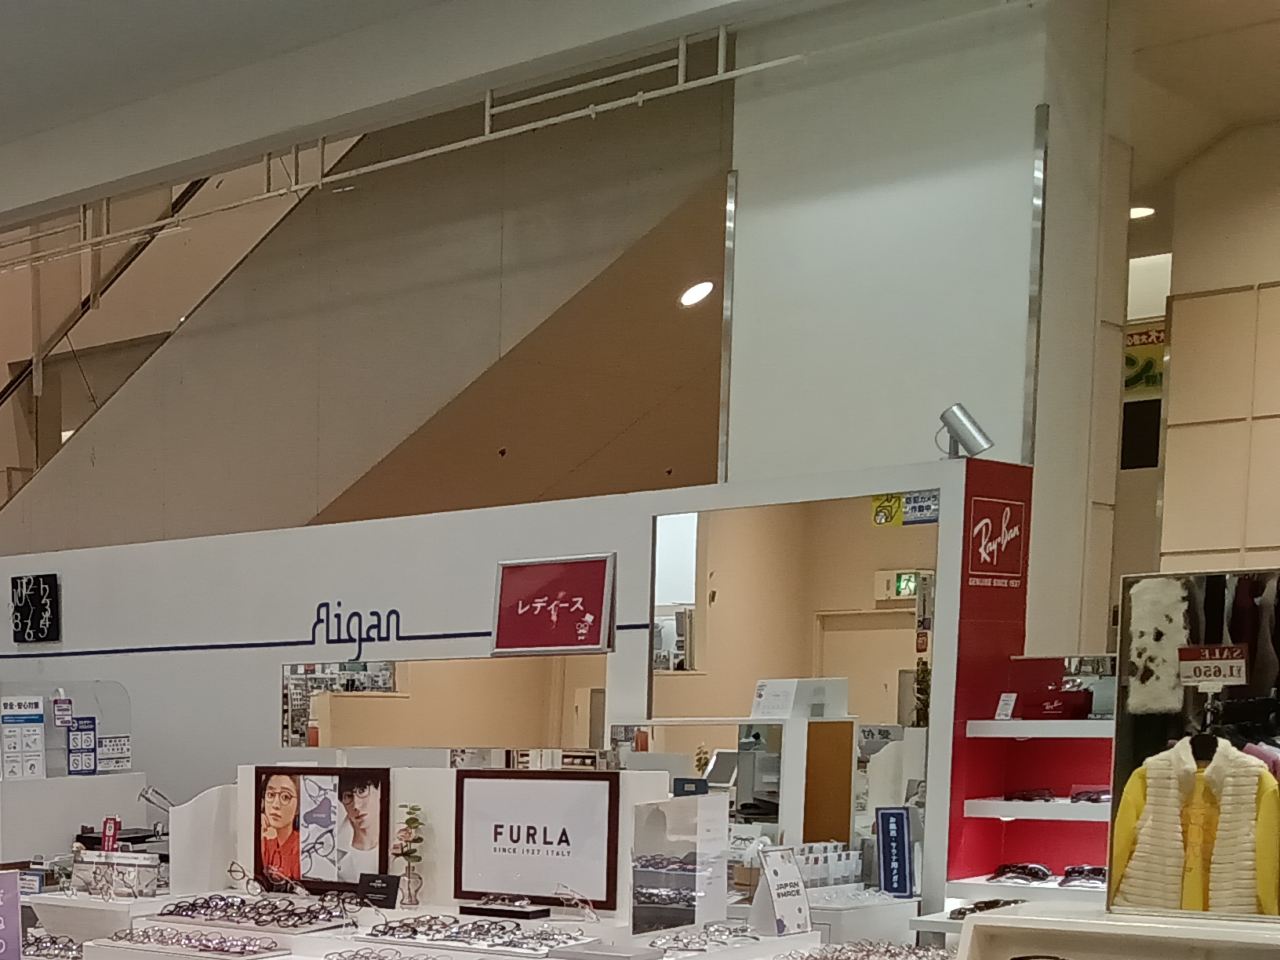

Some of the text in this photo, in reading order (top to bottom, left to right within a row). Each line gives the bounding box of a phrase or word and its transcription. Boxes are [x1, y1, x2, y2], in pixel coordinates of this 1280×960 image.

[517, 597, 585, 615] レディース
[493, 824, 571, 846] FURLA
[546, 849, 571, 857] ITALY
[775, 881, 800, 891] JAPAN
